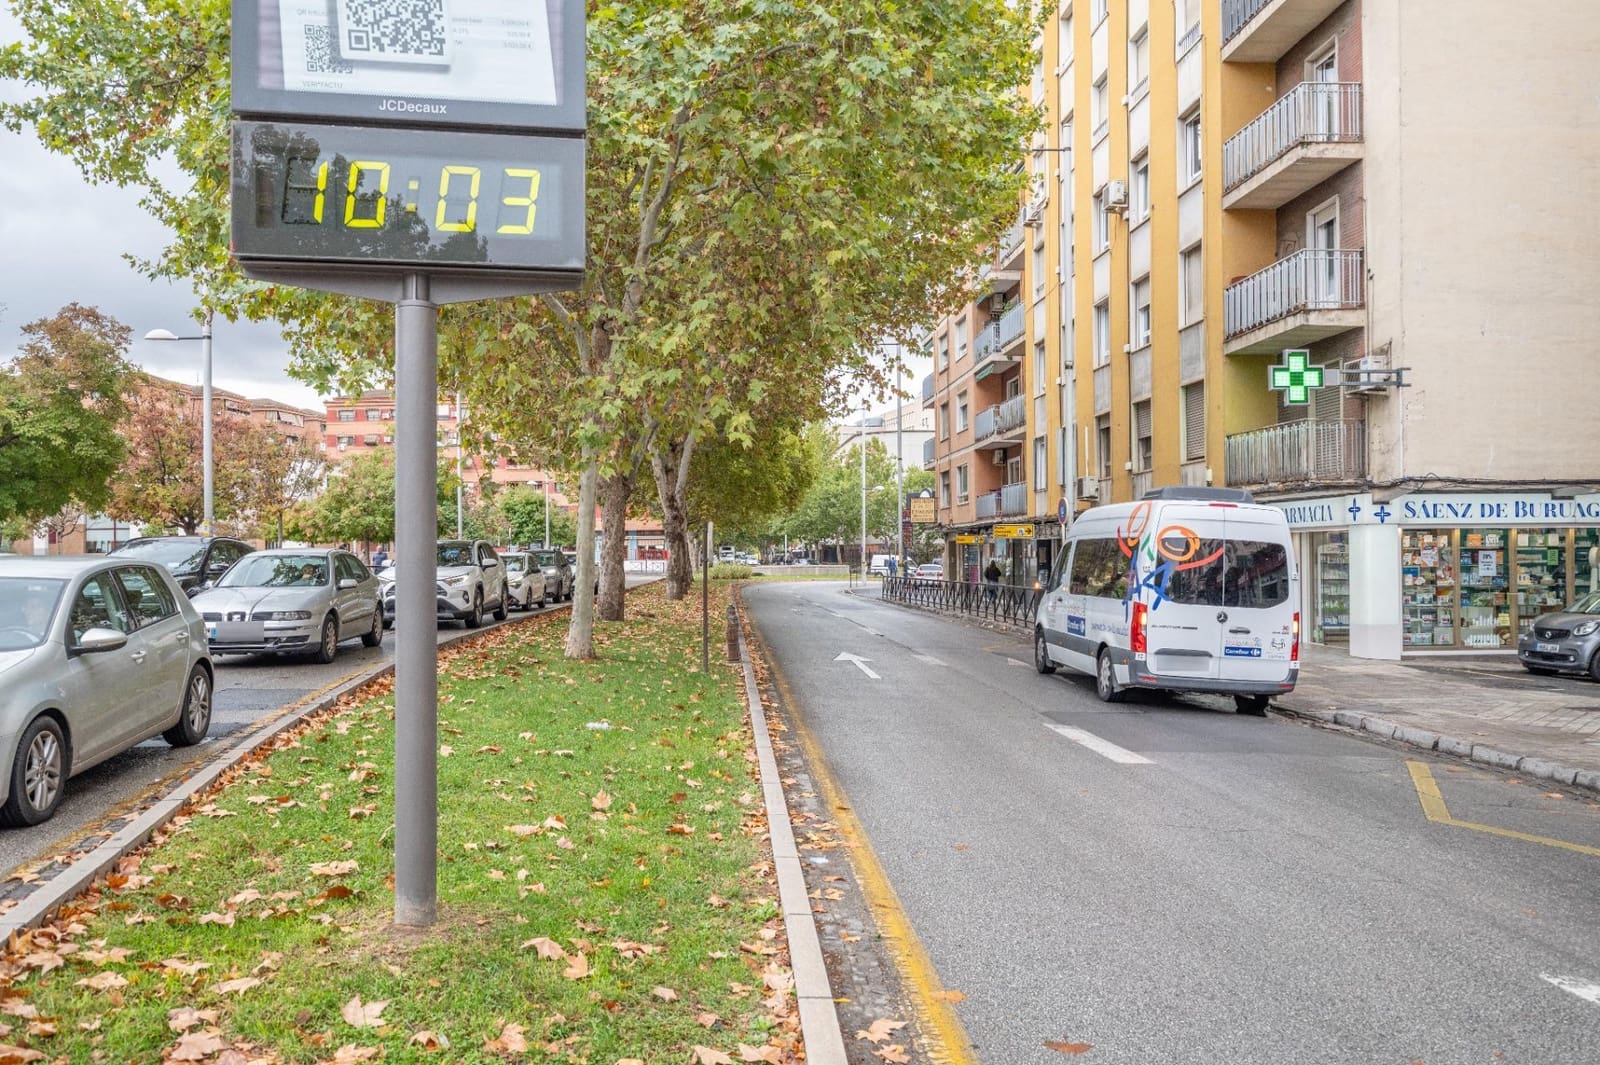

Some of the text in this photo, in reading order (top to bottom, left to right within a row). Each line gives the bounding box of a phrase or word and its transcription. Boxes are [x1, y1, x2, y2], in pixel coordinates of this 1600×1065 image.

[379, 100, 447, 114] JCDecaux
[313, 160, 541, 234] 10:03
[1282, 504, 1333, 524] ARMACIA
[1404, 500, 1473, 518] SÁENZ
[1480, 503, 1508, 518] DE
